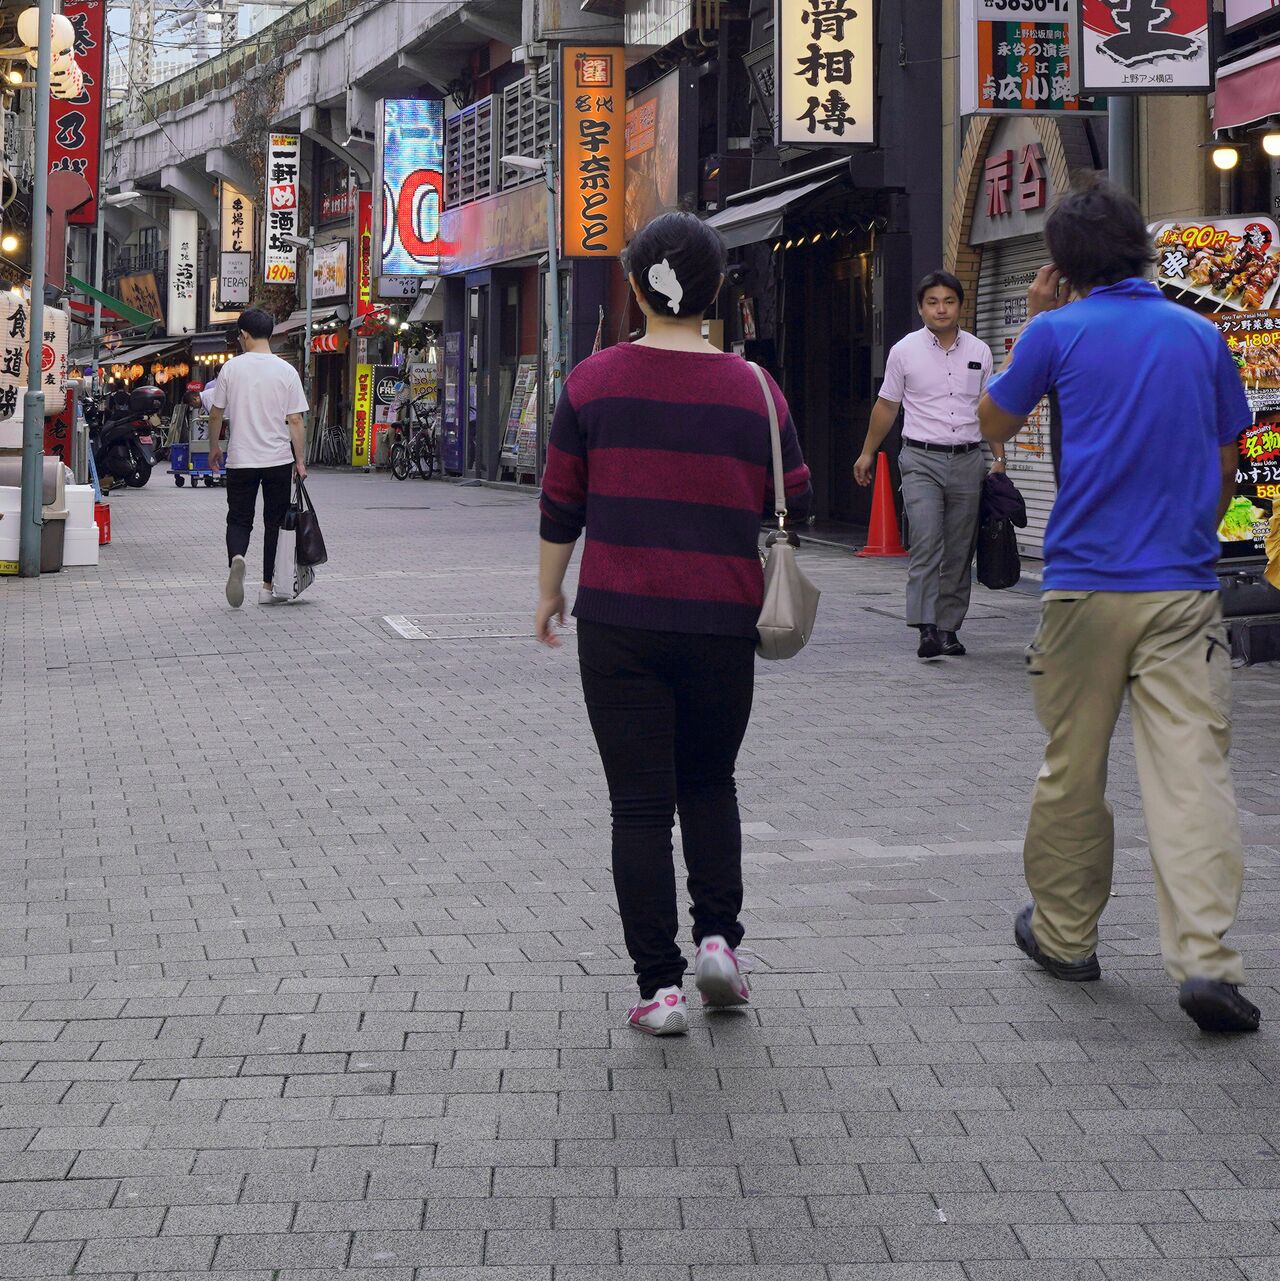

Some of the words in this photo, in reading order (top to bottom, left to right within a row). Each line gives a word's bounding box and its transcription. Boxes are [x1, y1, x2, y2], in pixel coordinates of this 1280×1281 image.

[1121, 73, 1174, 85] 上野アメ横店
[579, 119, 612, 251] 宇奈とと
[269, 150, 298, 254] 一軒め酒場
[266, 264, 296, 281] 190円
[1162, 250, 1189, 279] 串
[222, 277, 248, 288] TERAS
